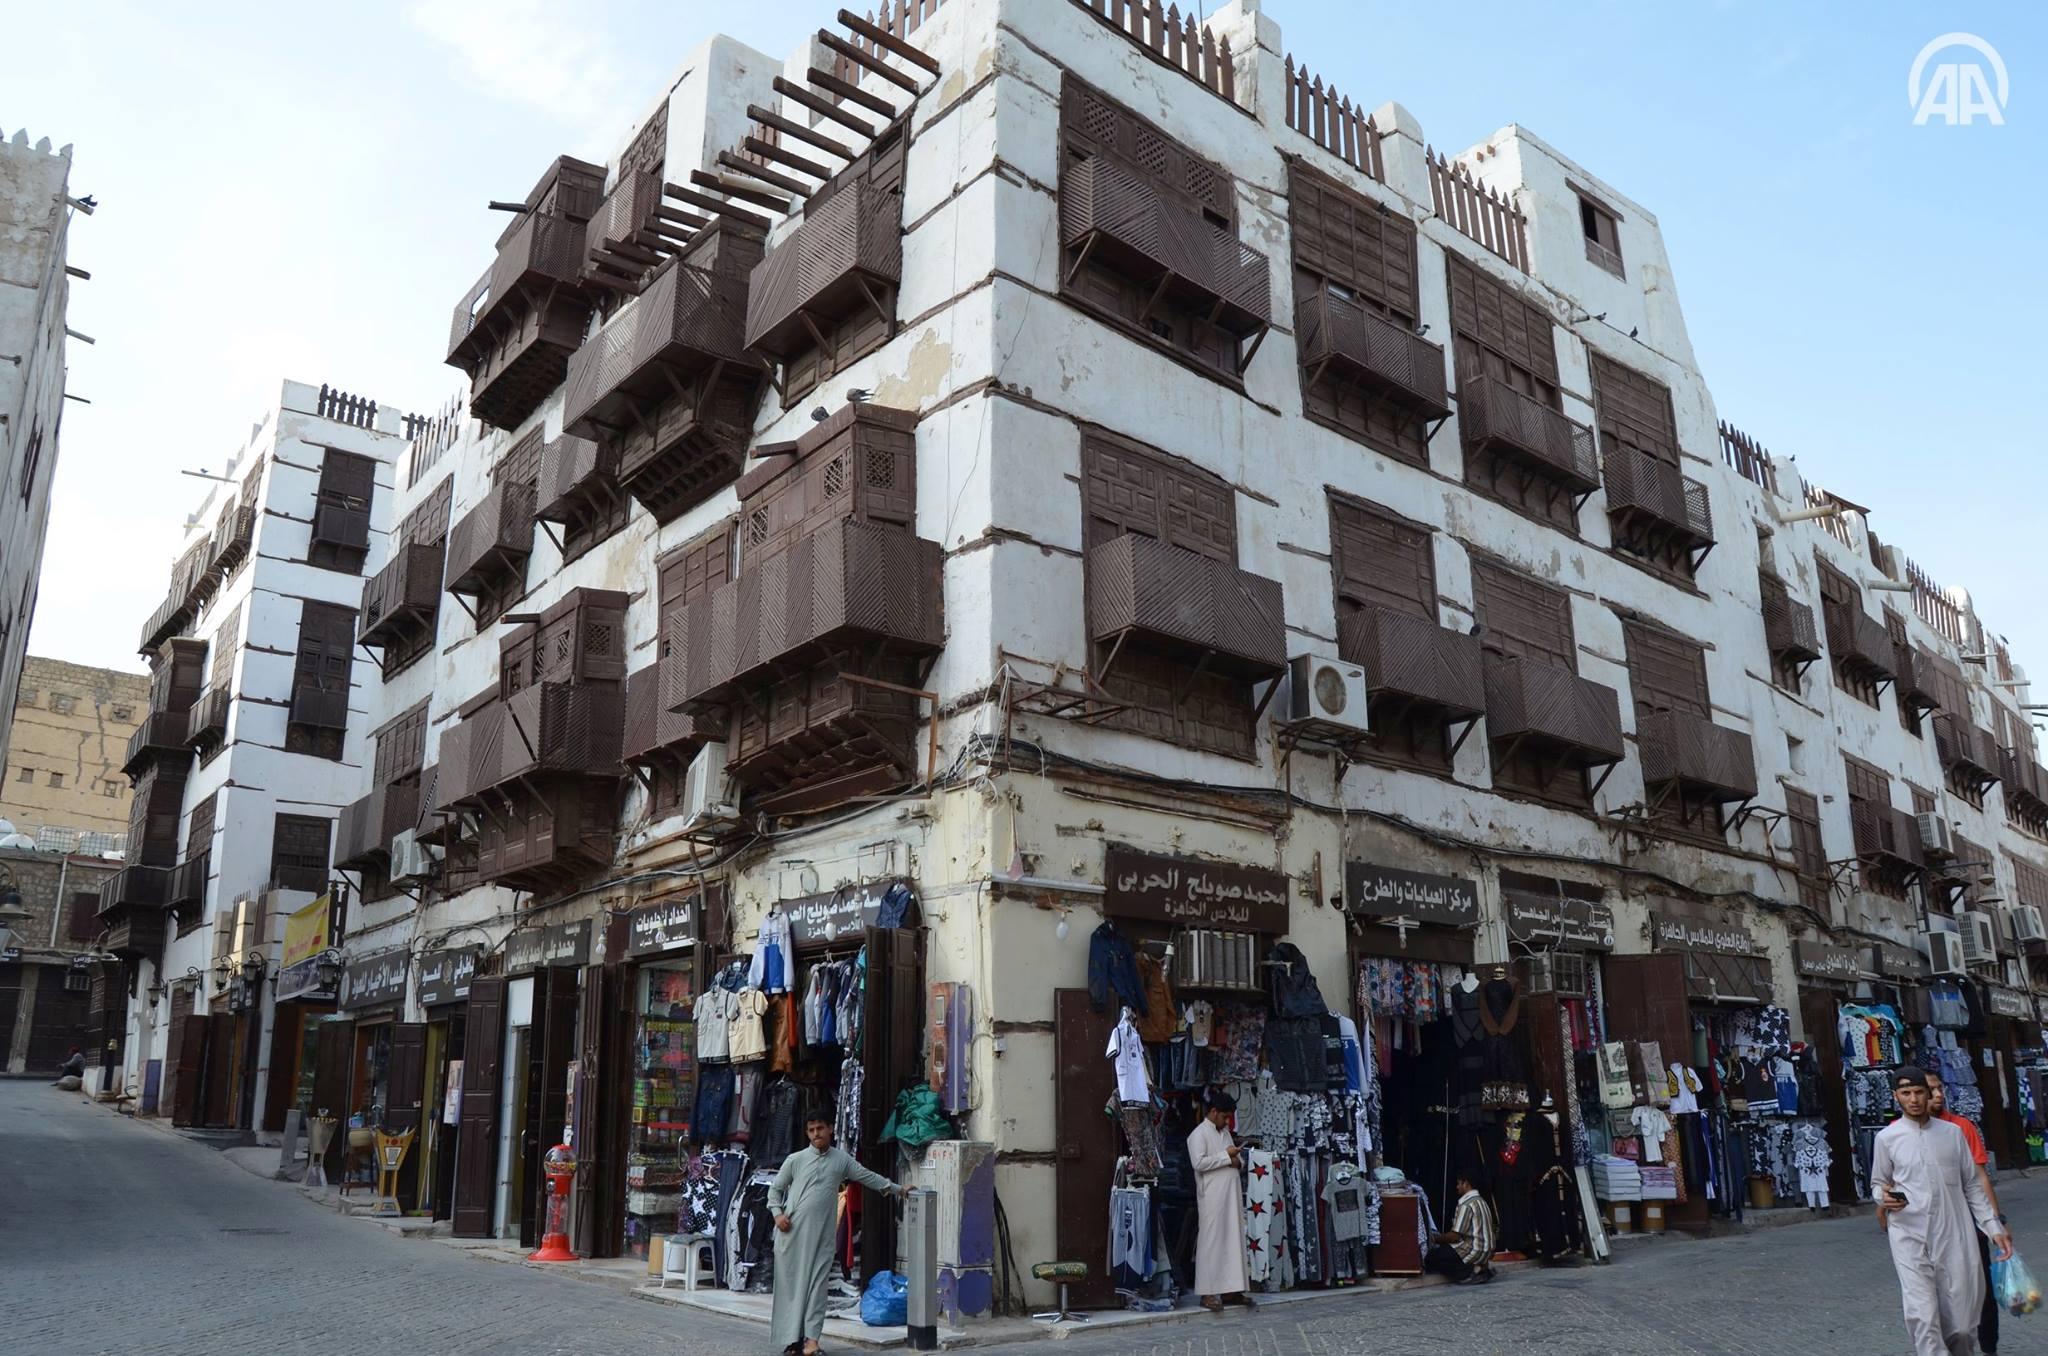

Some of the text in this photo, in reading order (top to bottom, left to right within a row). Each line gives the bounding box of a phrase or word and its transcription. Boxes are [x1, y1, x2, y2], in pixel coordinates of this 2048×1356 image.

[1244, 883, 1287, 906] محمد
[1362, 877, 1472, 913] مركز العبايات والطرح
[1164, 897, 1207, 920] الجاهزة
[1659, 921, 1686, 943] الجاهزة
